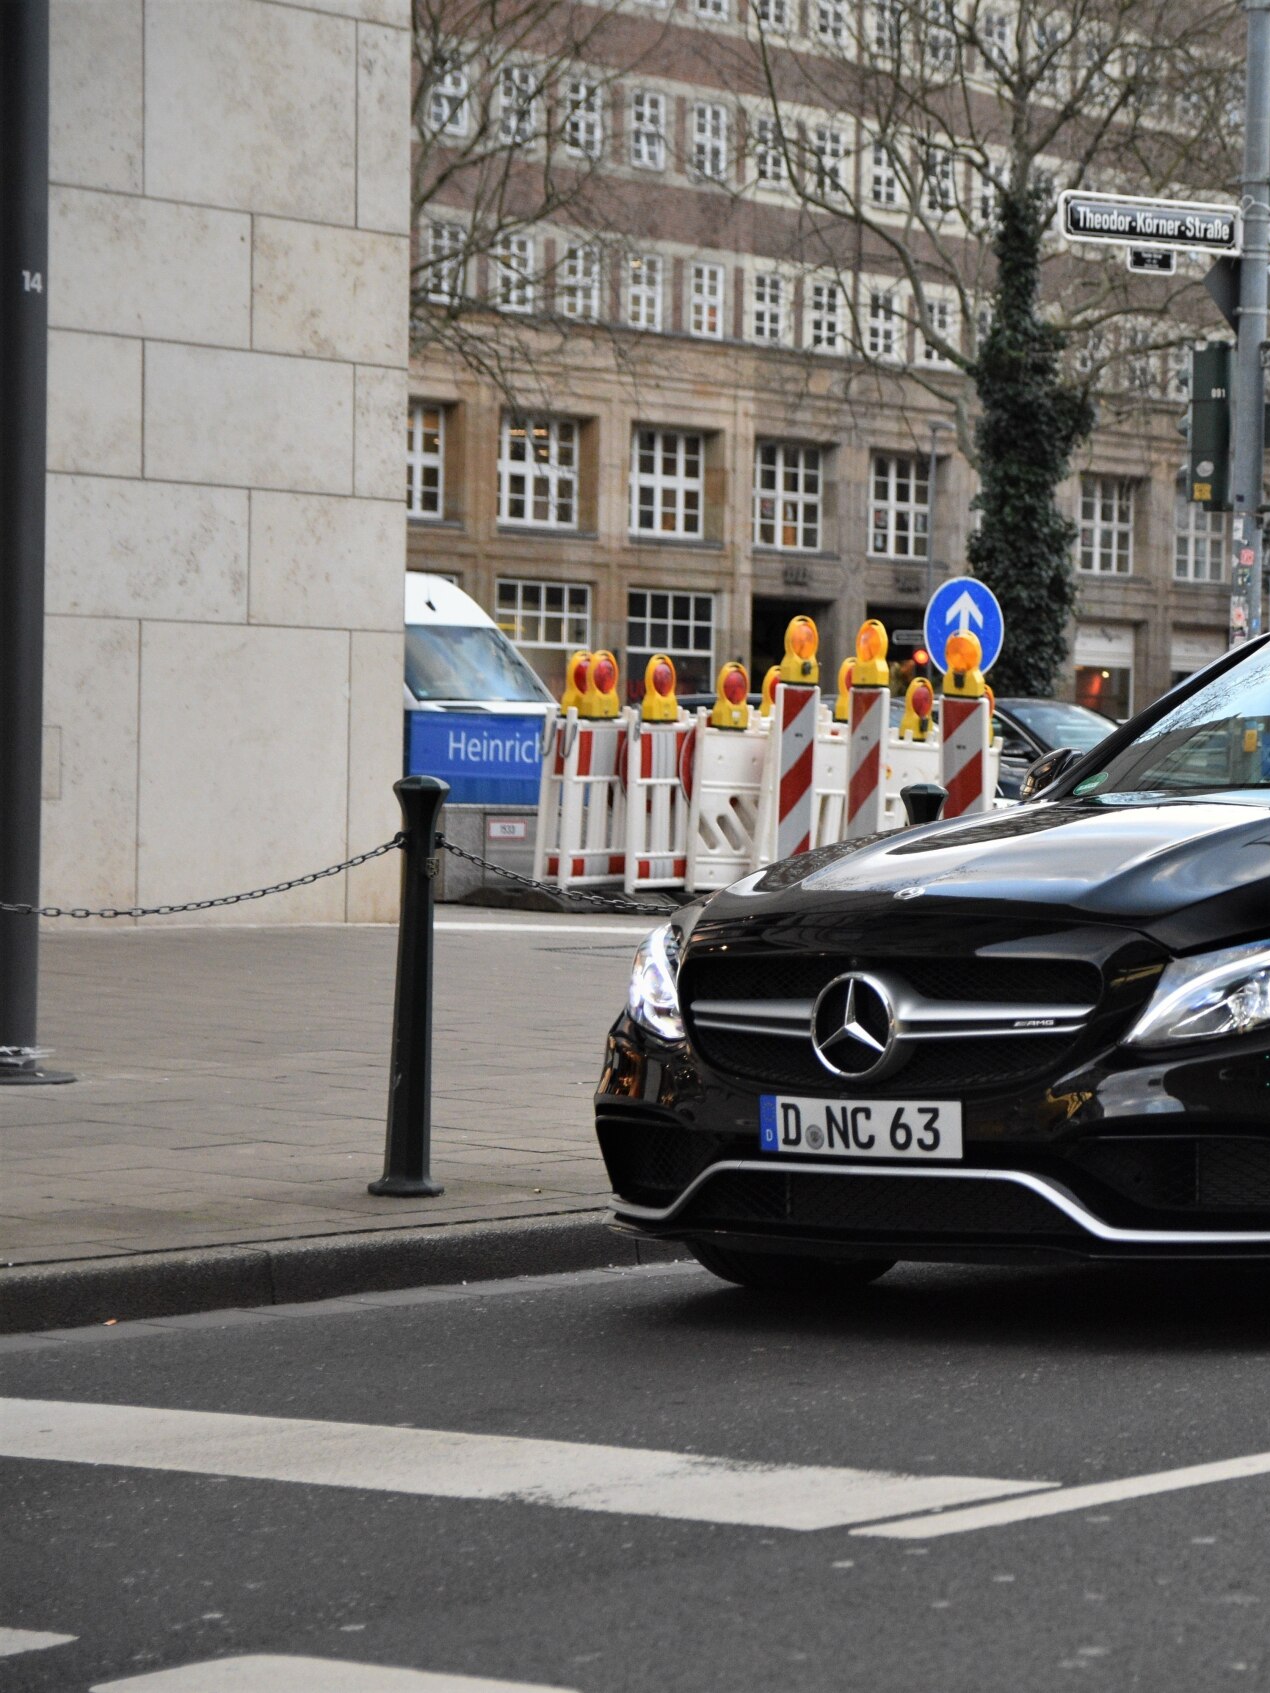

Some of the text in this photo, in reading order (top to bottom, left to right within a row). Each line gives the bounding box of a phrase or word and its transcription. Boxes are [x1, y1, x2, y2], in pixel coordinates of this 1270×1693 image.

[1077, 206, 1230, 240] Theodor-Körner-Straße
[22, 270, 42, 293] 14
[766, 1129, 773, 1142] D
[781, 1102, 940, 1151] D NC 63
